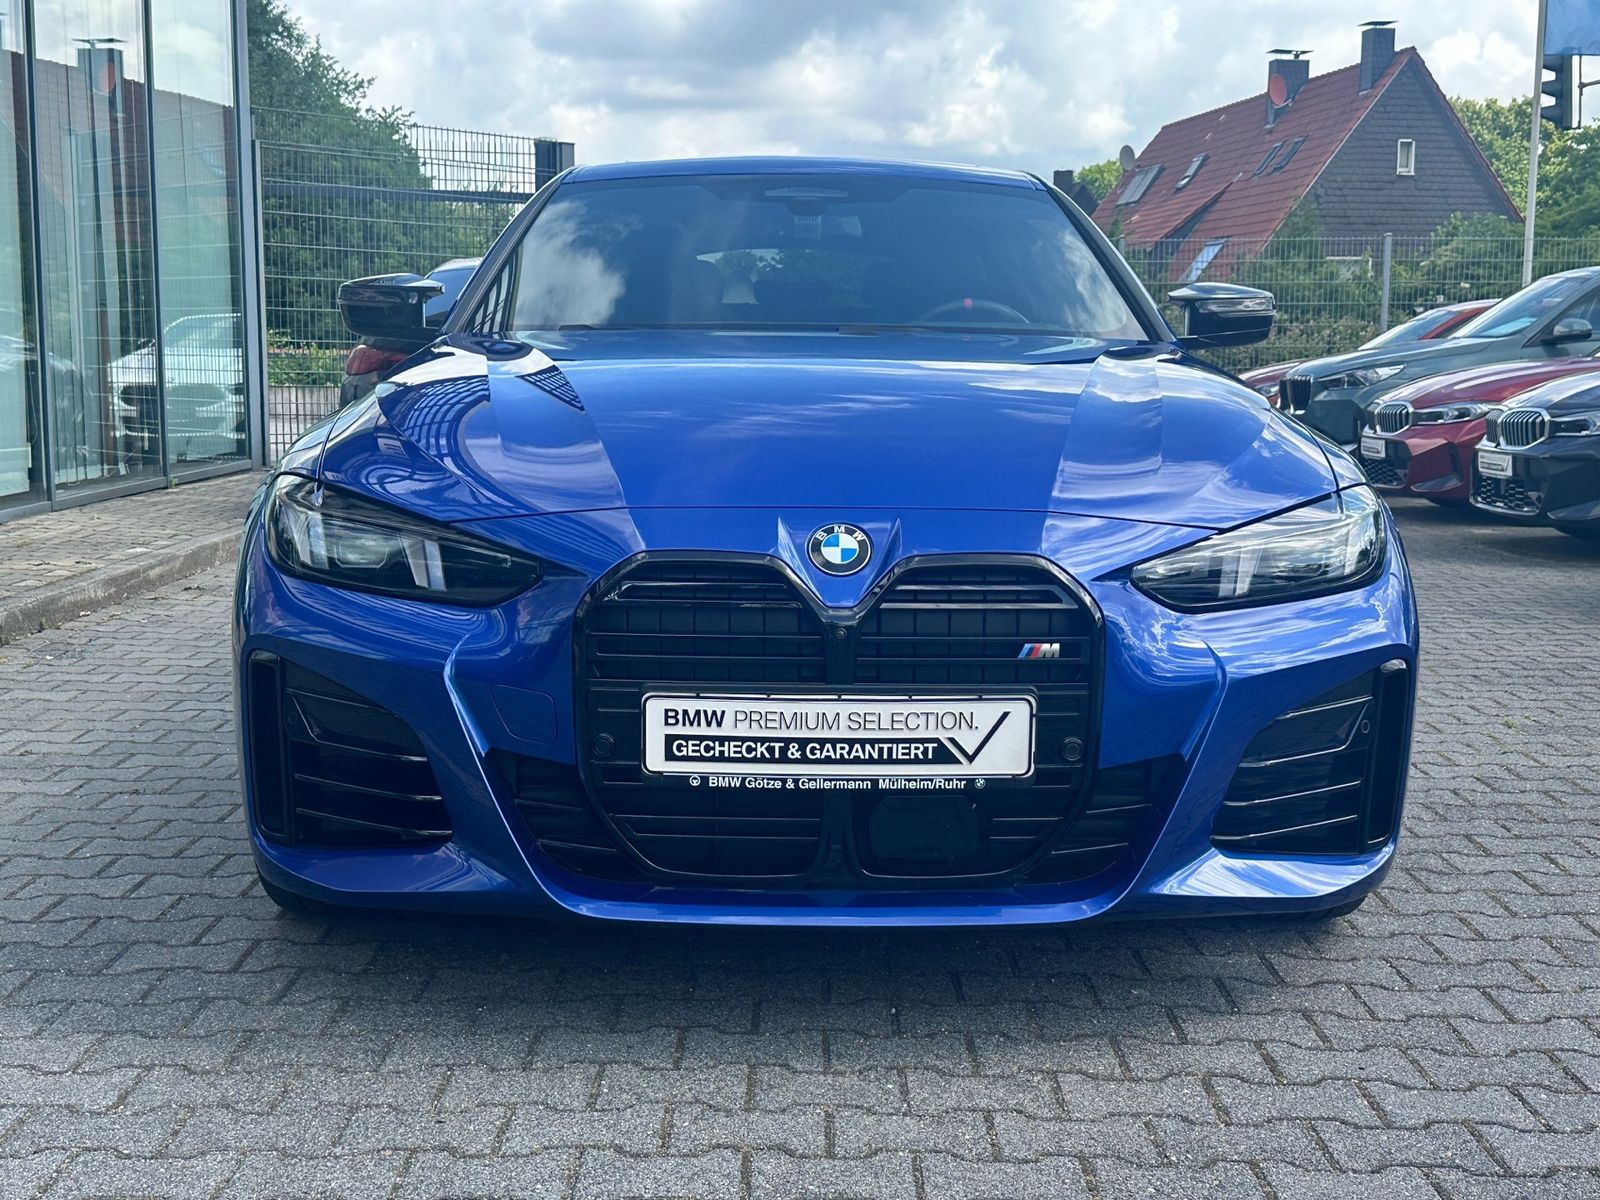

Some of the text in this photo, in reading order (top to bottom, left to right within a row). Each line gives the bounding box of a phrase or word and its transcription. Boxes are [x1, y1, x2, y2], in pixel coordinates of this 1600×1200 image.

[815, 525, 865, 541] BMW
[664, 708, 979, 731] BMW PREMIUM SELECTION.
[672, 740, 938, 760] GECHECKT & GARANTIERT
[708, 776, 967, 790] BMW Götze & Gellermann Mülheim/Ruhr
